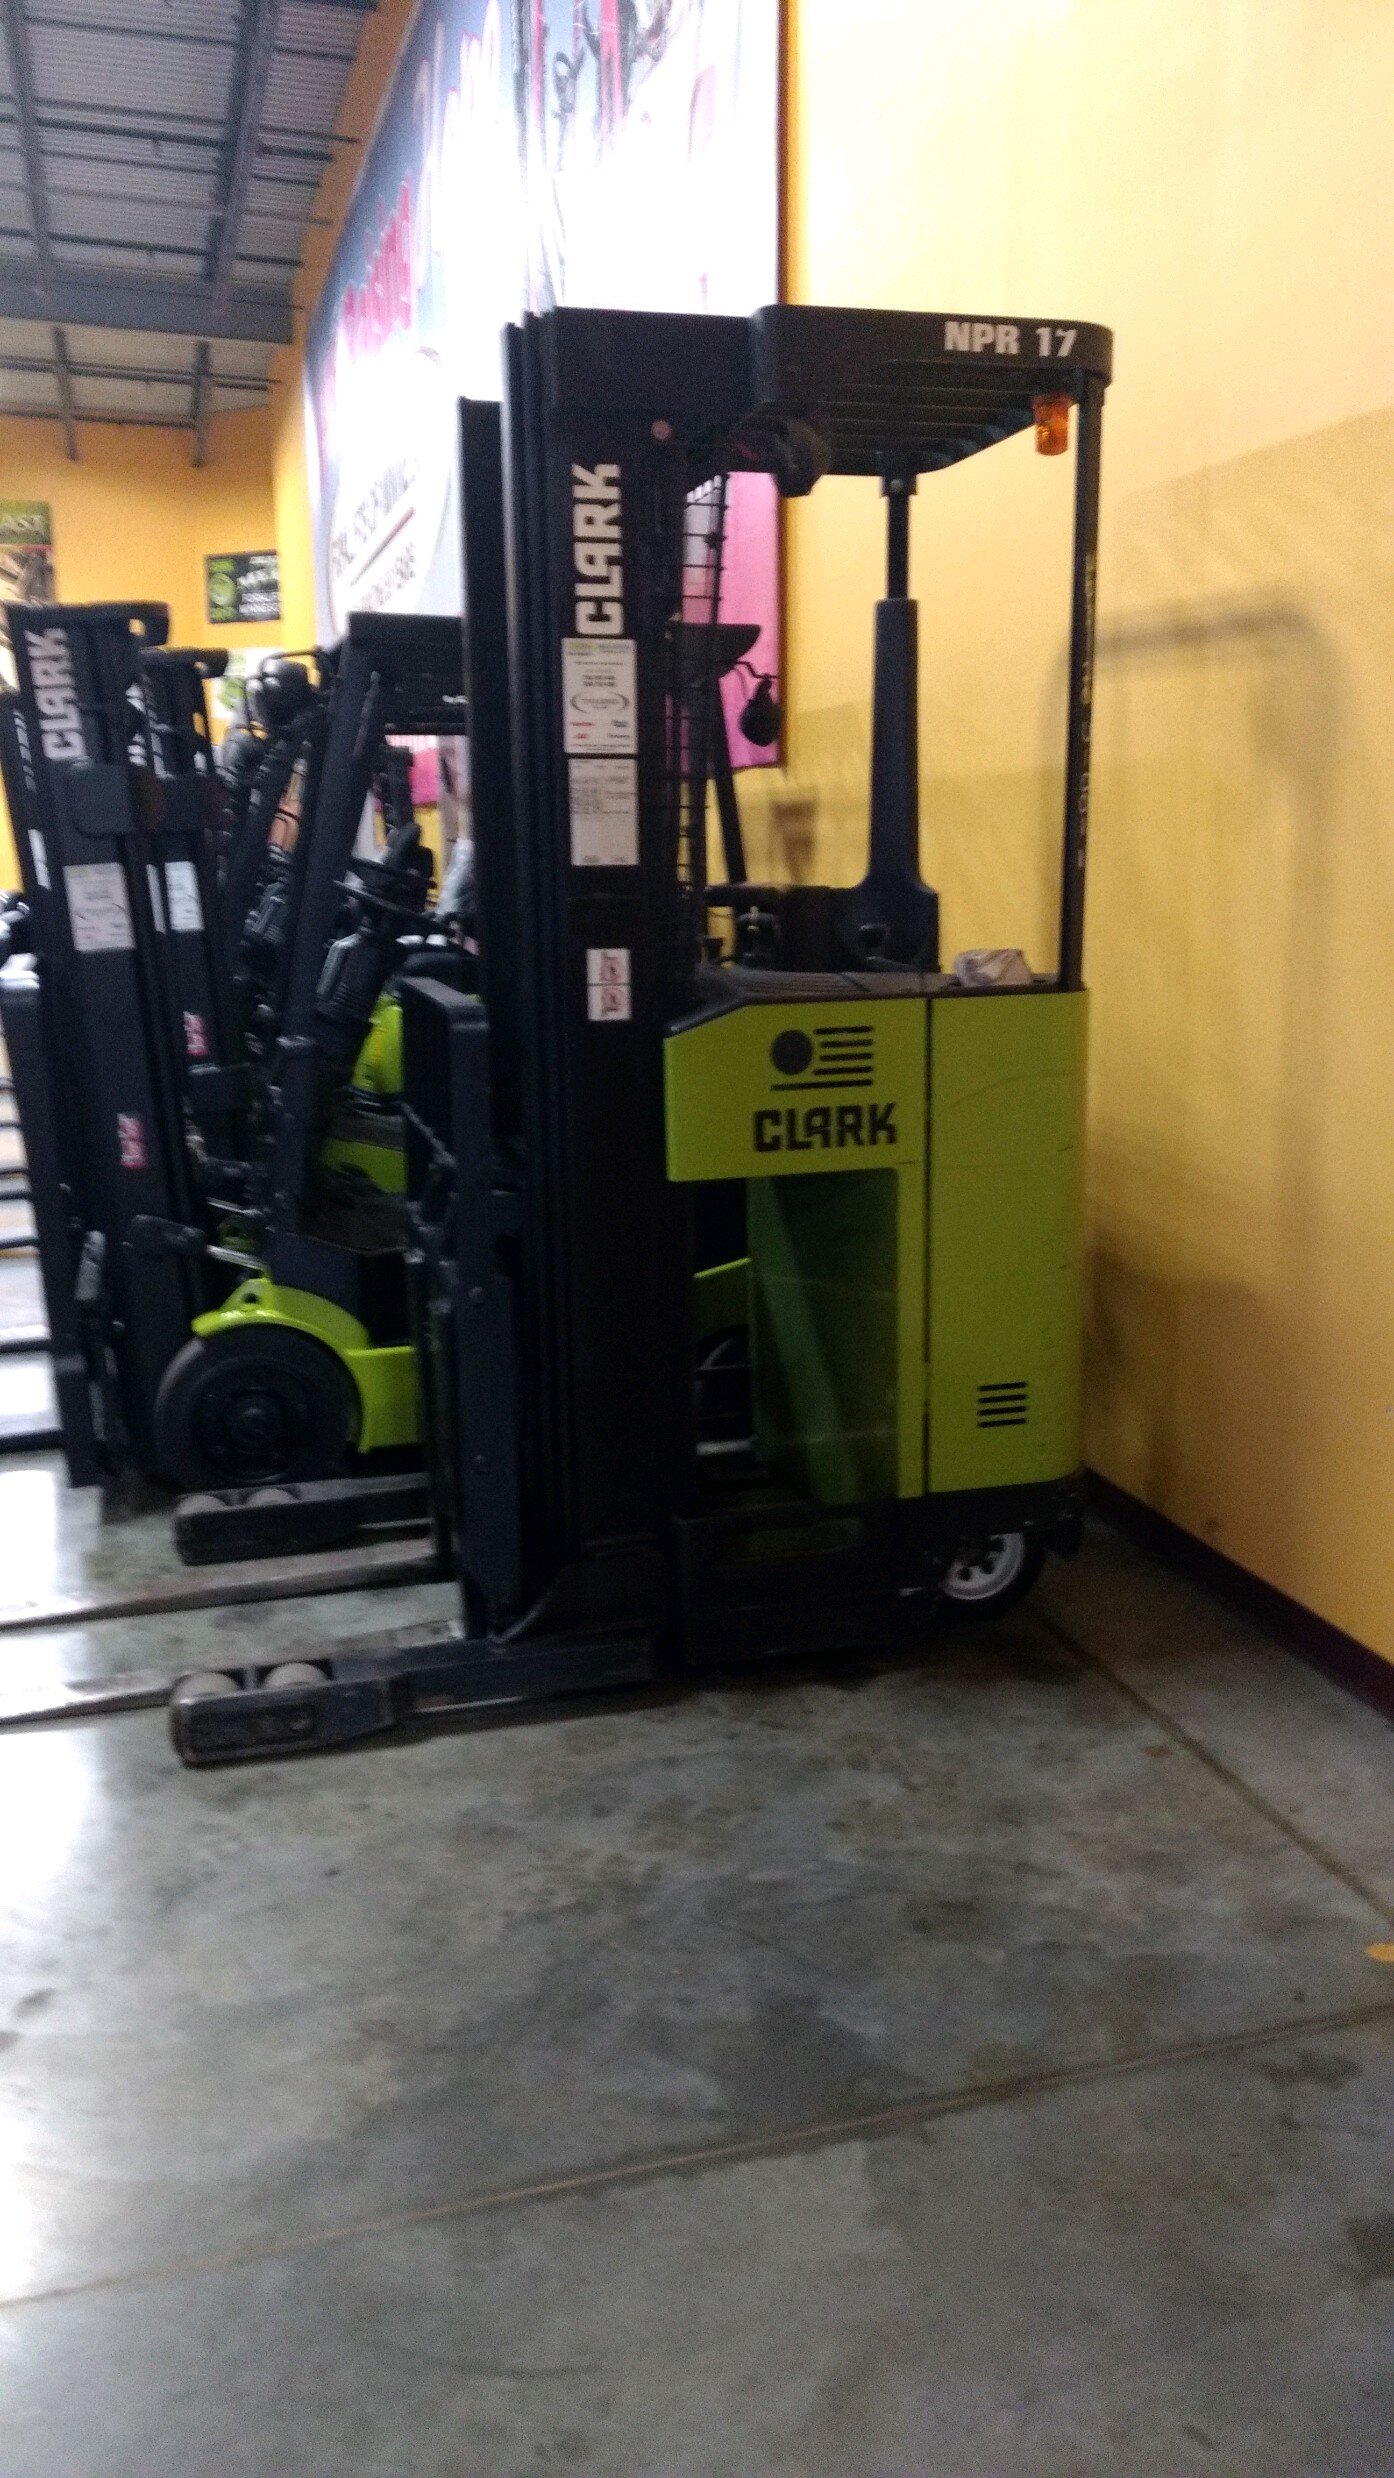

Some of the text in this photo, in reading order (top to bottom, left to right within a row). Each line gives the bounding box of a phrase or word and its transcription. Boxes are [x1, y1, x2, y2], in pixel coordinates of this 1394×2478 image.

[944, 320, 1077, 357] NPR 17
[571, 463, 624, 635] CLARK
[24, 627, 86, 761] CLARK
[754, 1102, 897, 1152] CLARK
